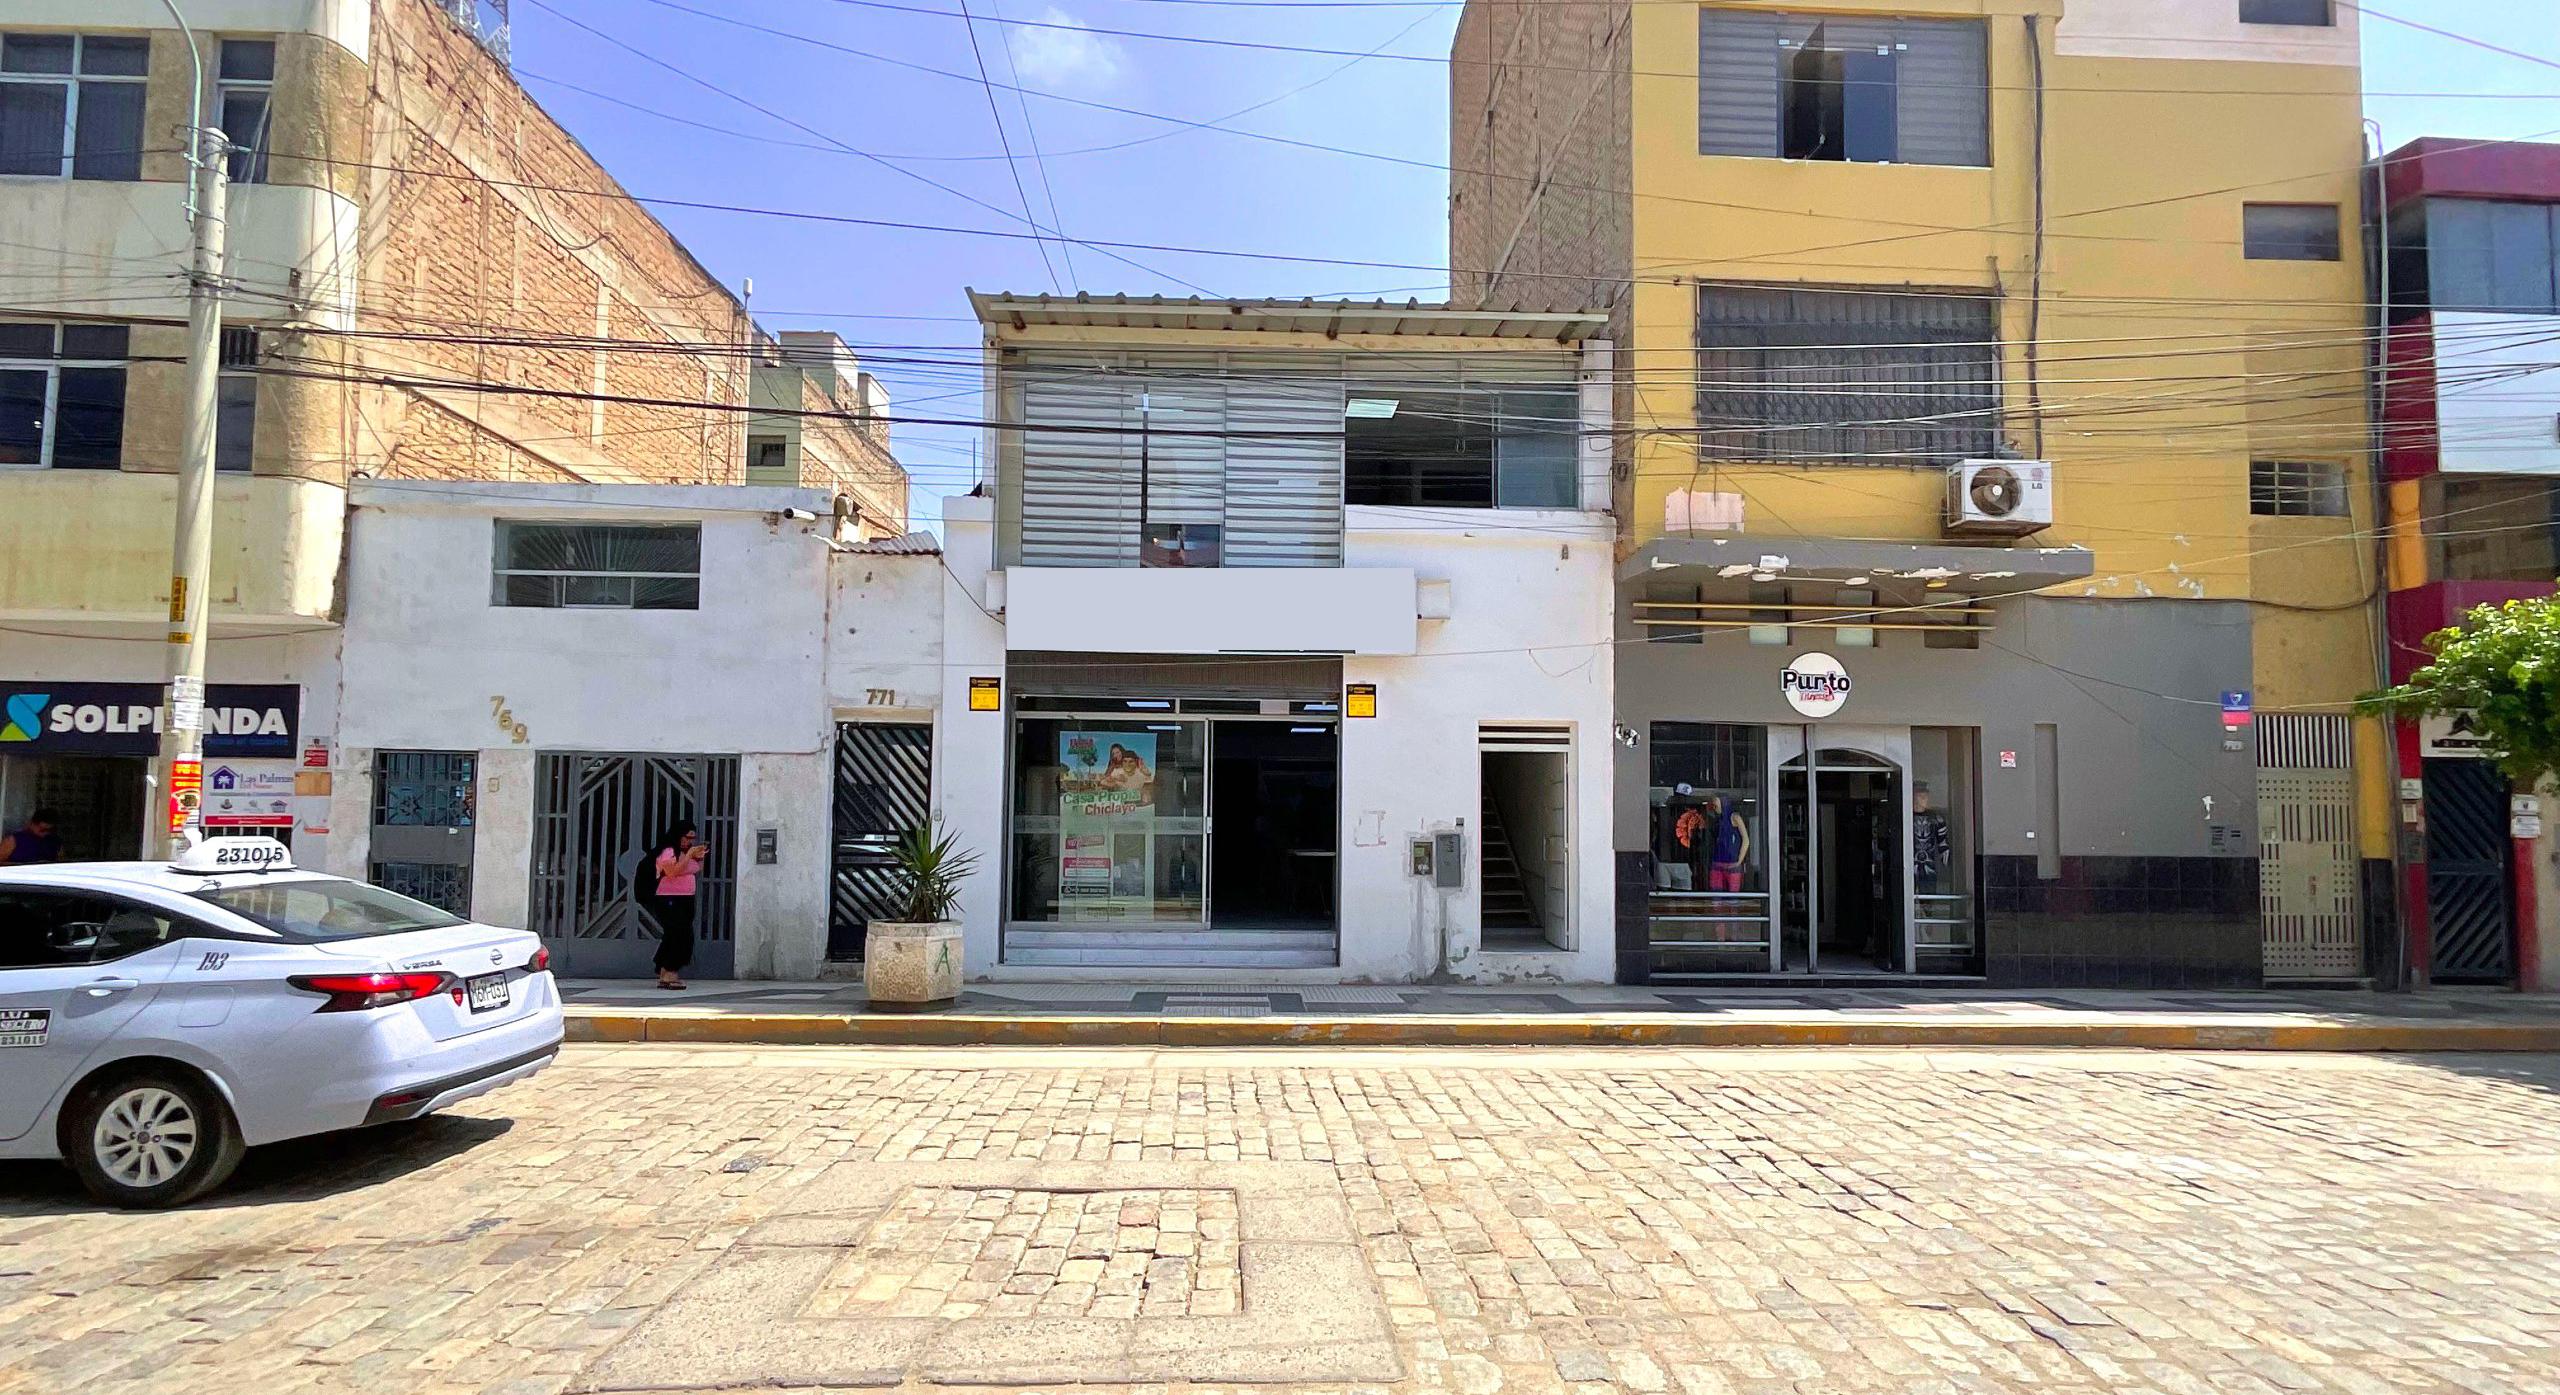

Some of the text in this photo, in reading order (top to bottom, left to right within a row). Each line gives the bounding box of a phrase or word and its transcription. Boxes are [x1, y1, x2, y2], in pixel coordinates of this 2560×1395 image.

[2031, 482, 2043, 490] LG
[1782, 671, 1850, 691] Punto
[866, 688, 895, 706] 771
[50, 703, 288, 735] SOLPNDA
[1063, 789, 1139, 804] Casa Propia
[1084, 803, 1136, 815] Chiclayo
[216, 847, 284, 864] 231015
[196, 952, 230, 971] 193
